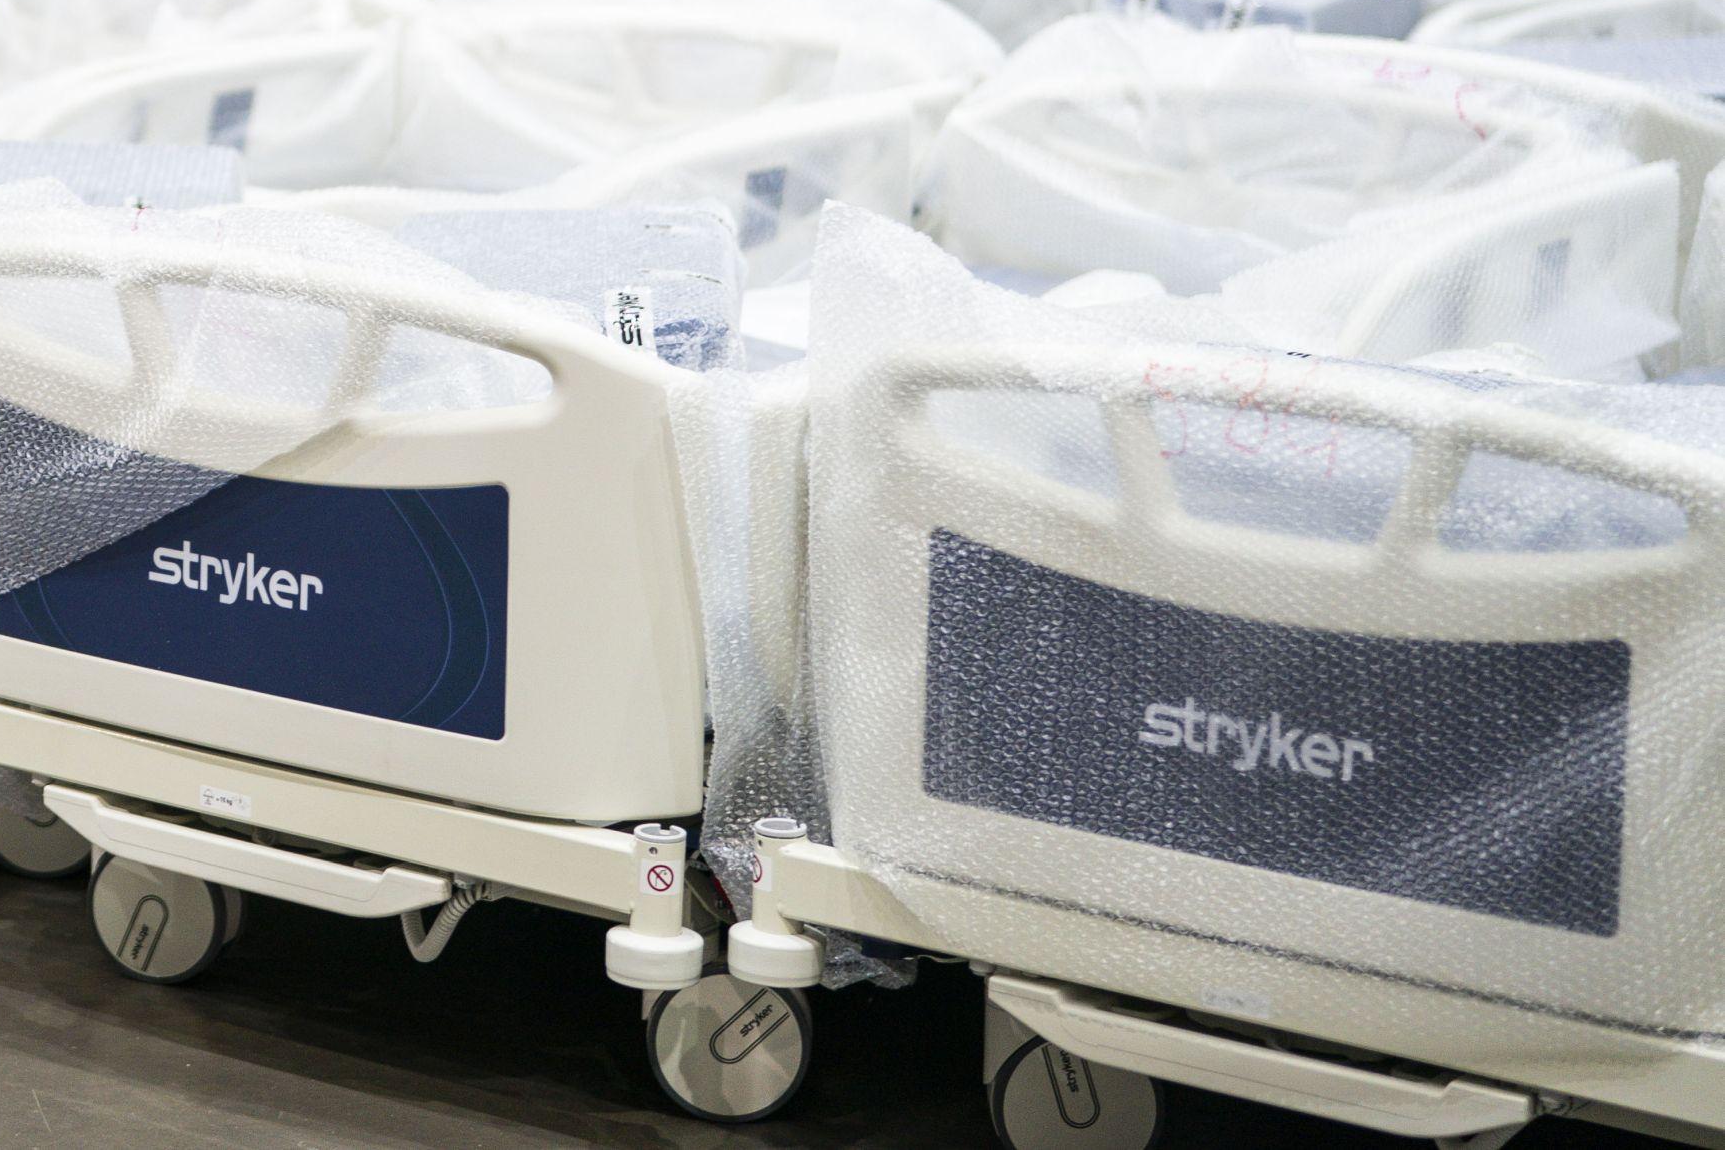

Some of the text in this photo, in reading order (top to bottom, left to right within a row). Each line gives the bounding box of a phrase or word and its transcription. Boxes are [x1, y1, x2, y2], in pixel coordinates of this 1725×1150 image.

[148, 540, 324, 612] stryker
[1138, 696, 1374, 782] stryker
[739, 1004, 773, 1038] stryker
